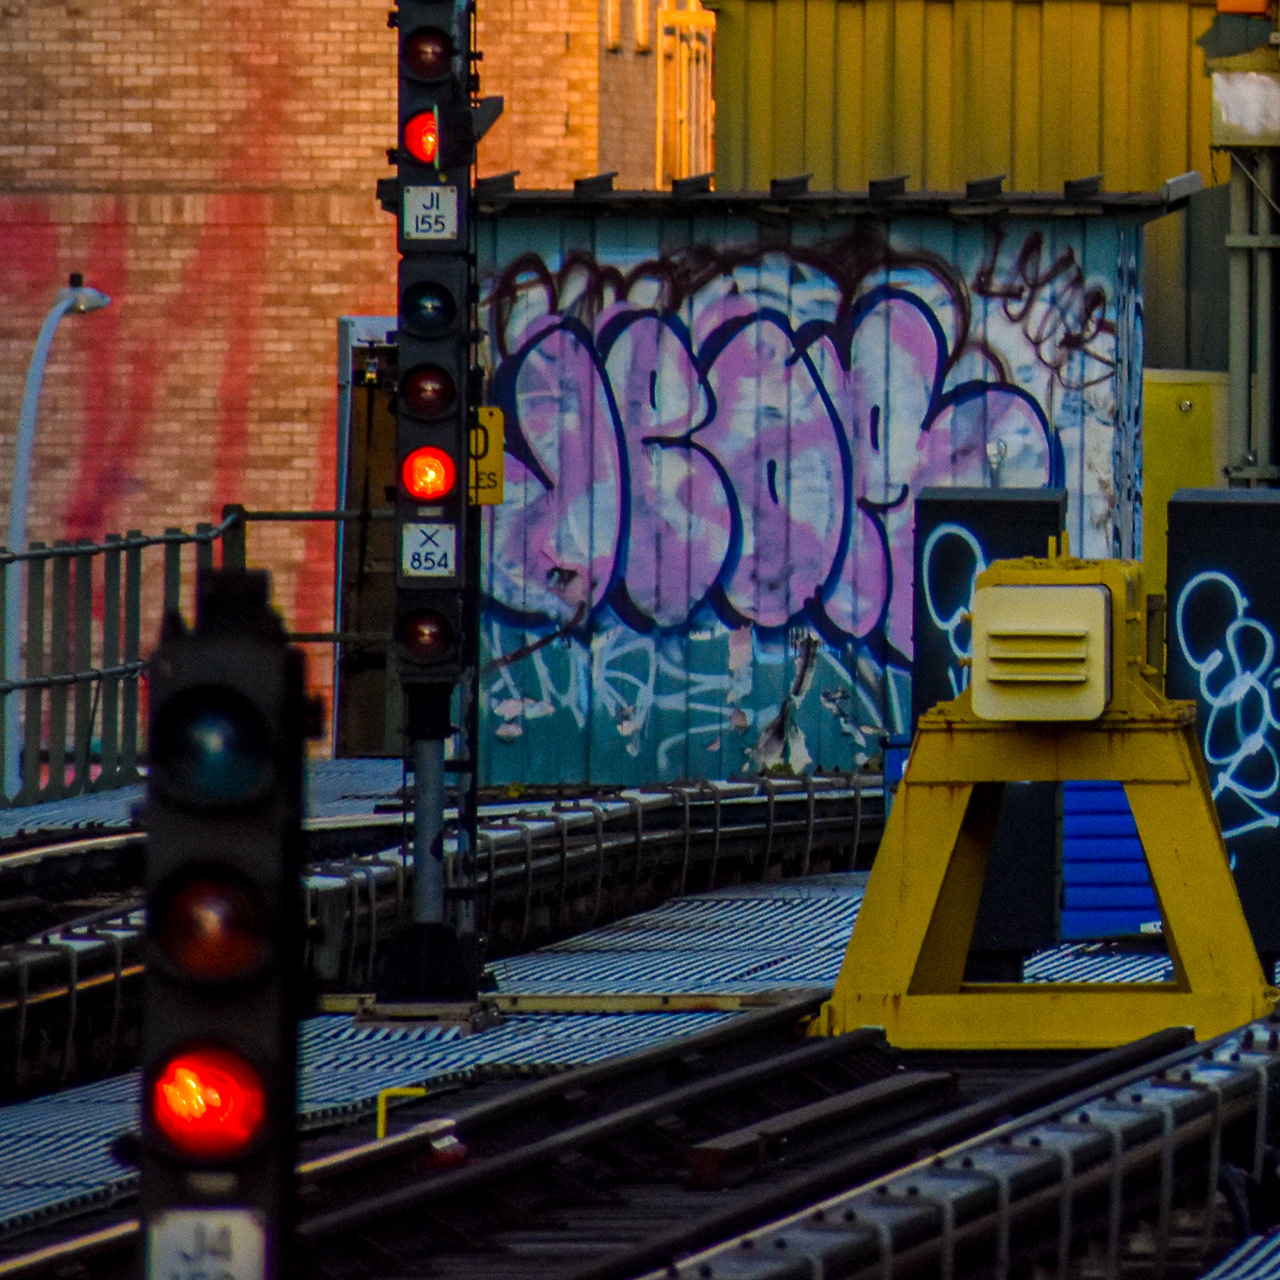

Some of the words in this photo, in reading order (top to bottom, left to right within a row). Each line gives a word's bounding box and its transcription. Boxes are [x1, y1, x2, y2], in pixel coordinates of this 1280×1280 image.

[415, 214, 447, 234] 155
[419, 529, 440, 548] X
[411, 552, 449, 570] 854
